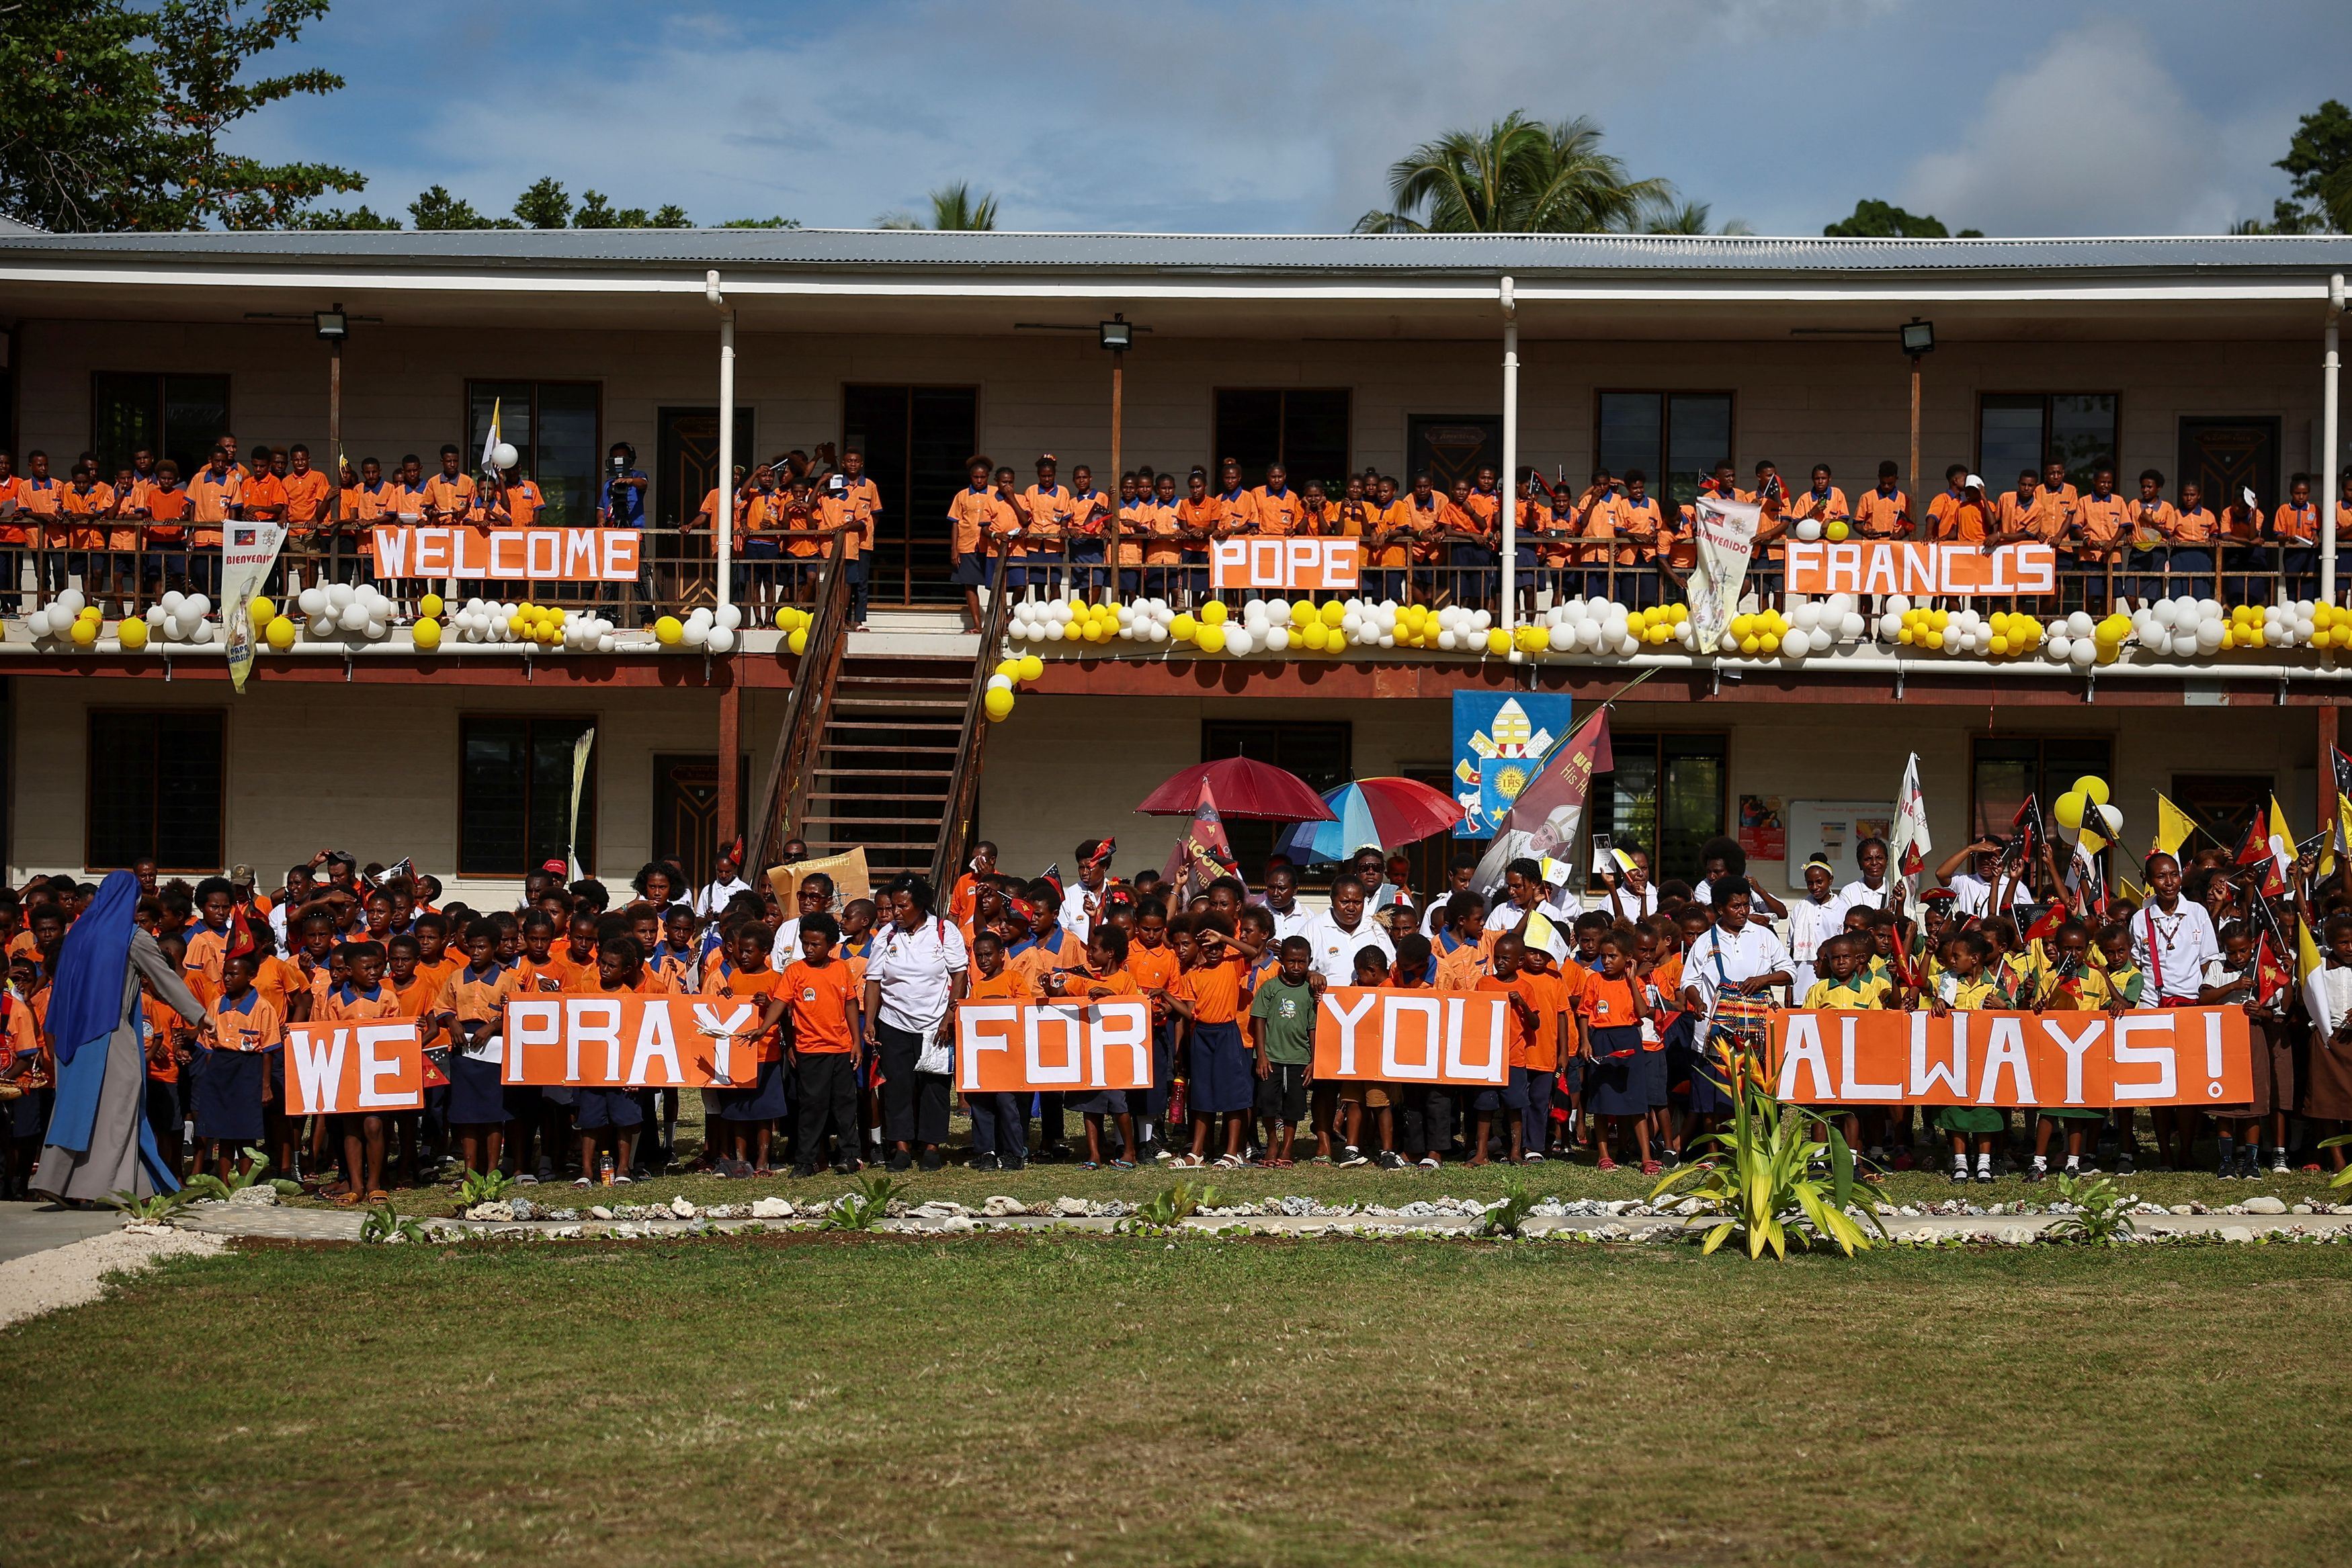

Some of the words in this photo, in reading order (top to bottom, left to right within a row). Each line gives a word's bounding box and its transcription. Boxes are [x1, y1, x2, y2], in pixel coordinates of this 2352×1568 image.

[375, 527, 638, 580] WELCOME
[1212, 538, 1359, 589] POPE
[1787, 540, 2056, 593] FRANCIS
[289, 1024, 418, 1115] WE
[507, 998, 755, 1086] PRAY
[959, 1002, 1150, 1090] FOR
[1322, 993, 1506, 1082] YOU
[1775, 1010, 2224, 1104] ALWAYS!
